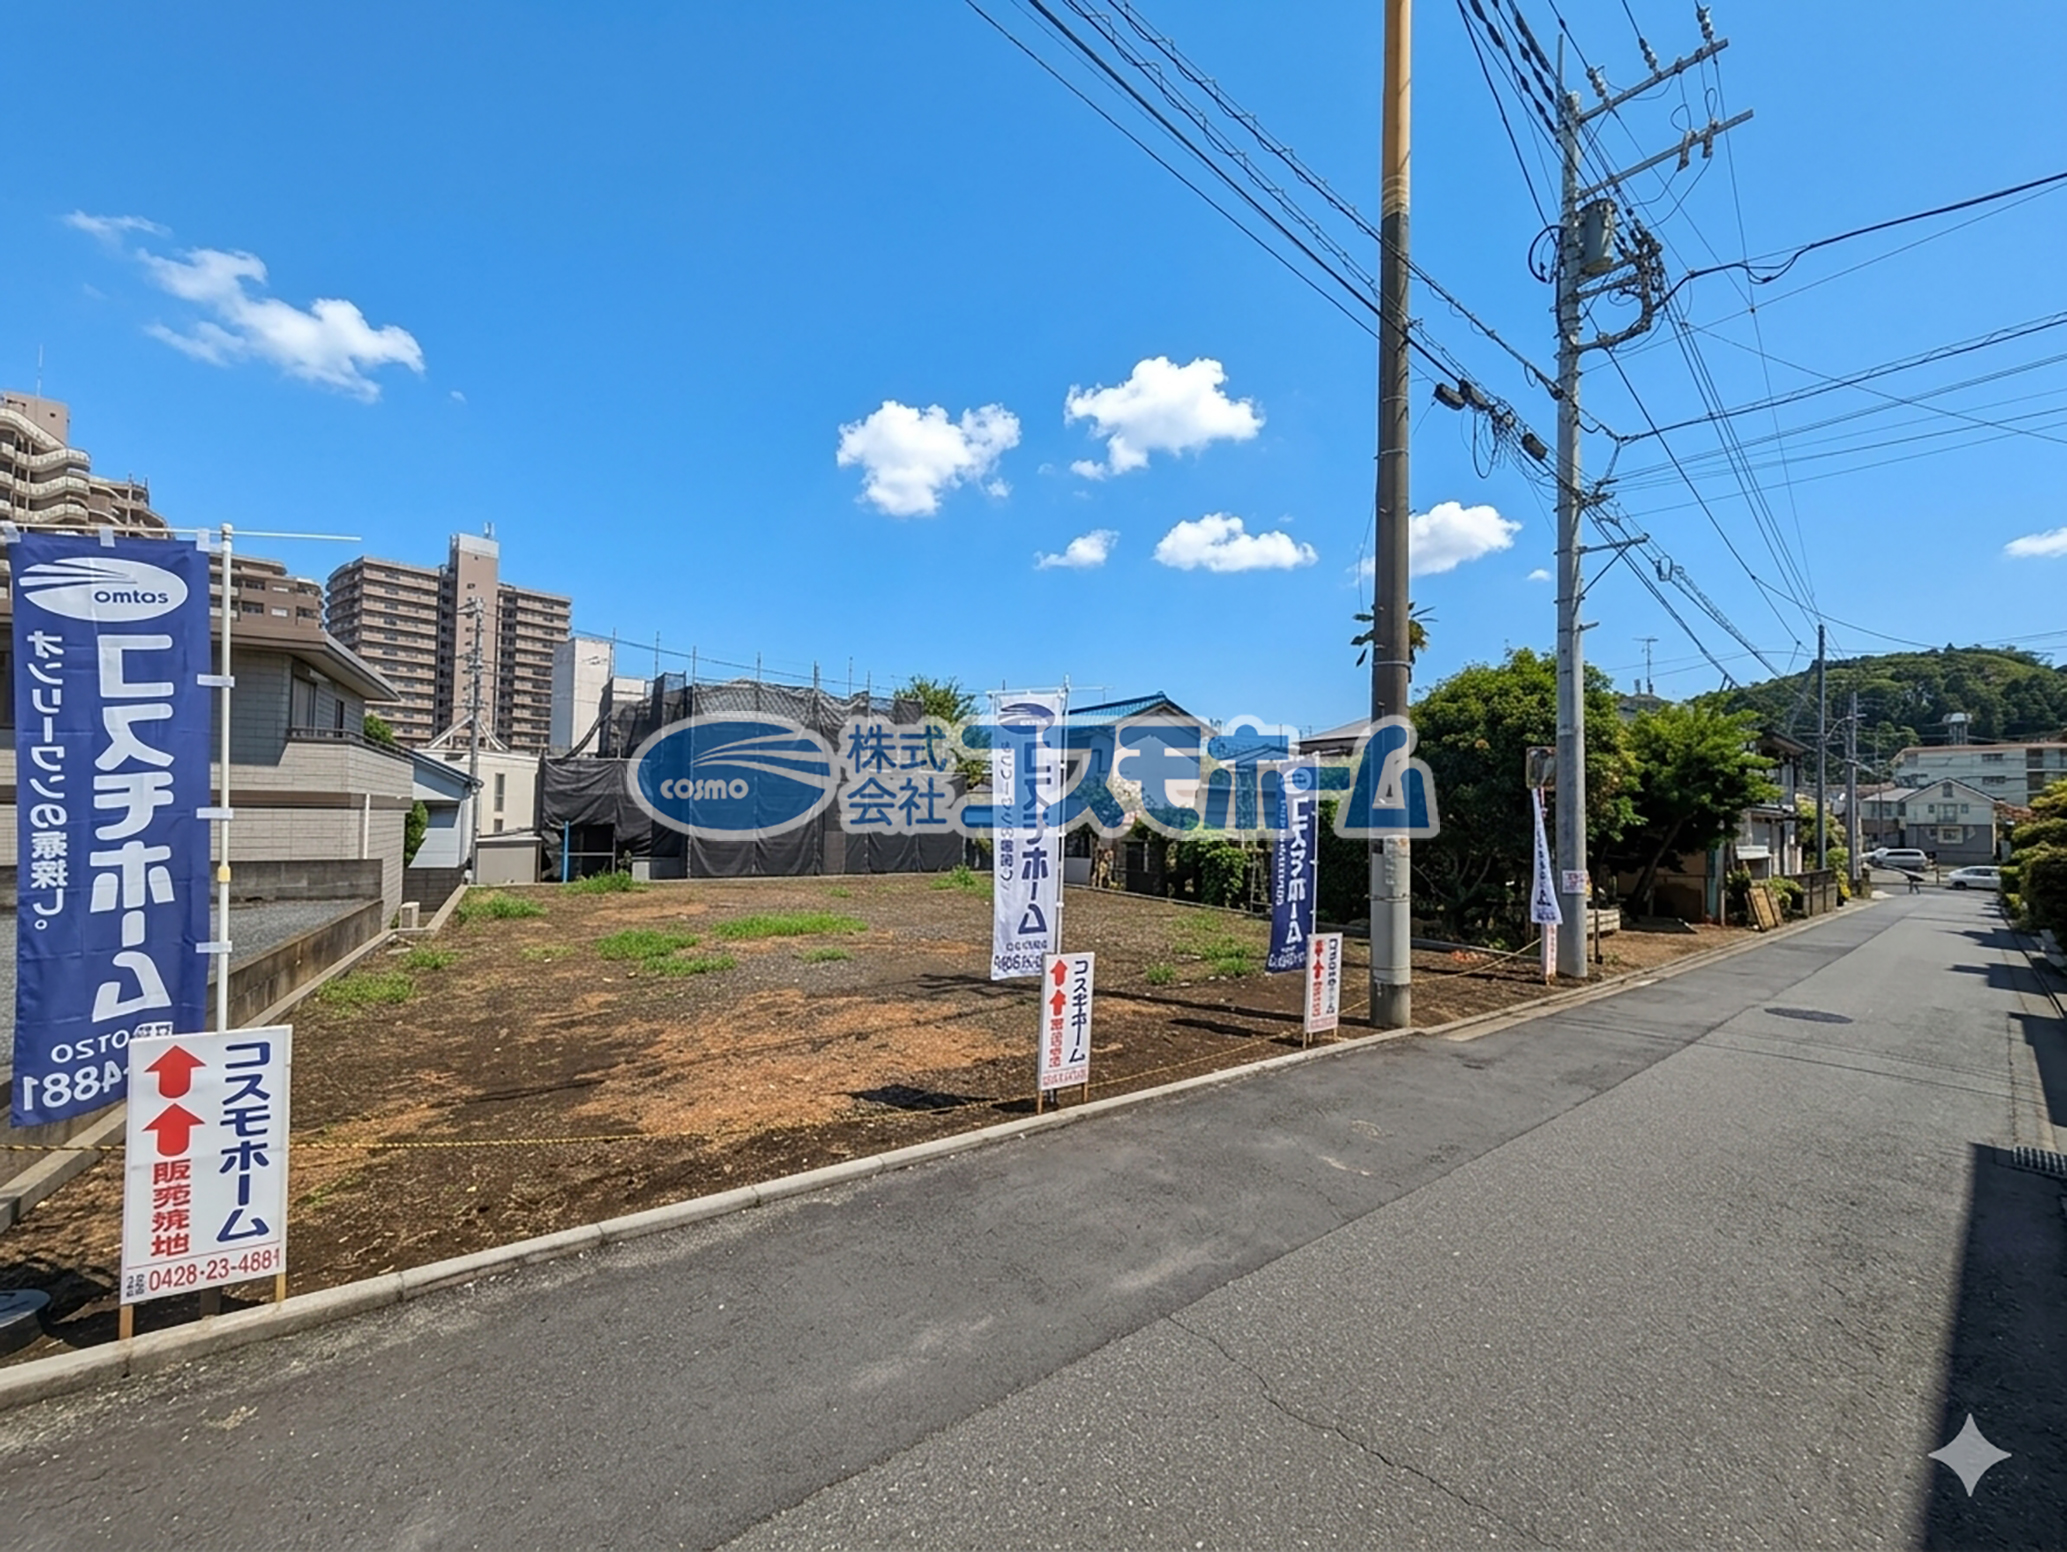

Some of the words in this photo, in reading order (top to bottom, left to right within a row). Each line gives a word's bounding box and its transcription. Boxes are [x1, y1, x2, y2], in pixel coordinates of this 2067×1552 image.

[216, 1041, 271, 1243] コスモホーム
